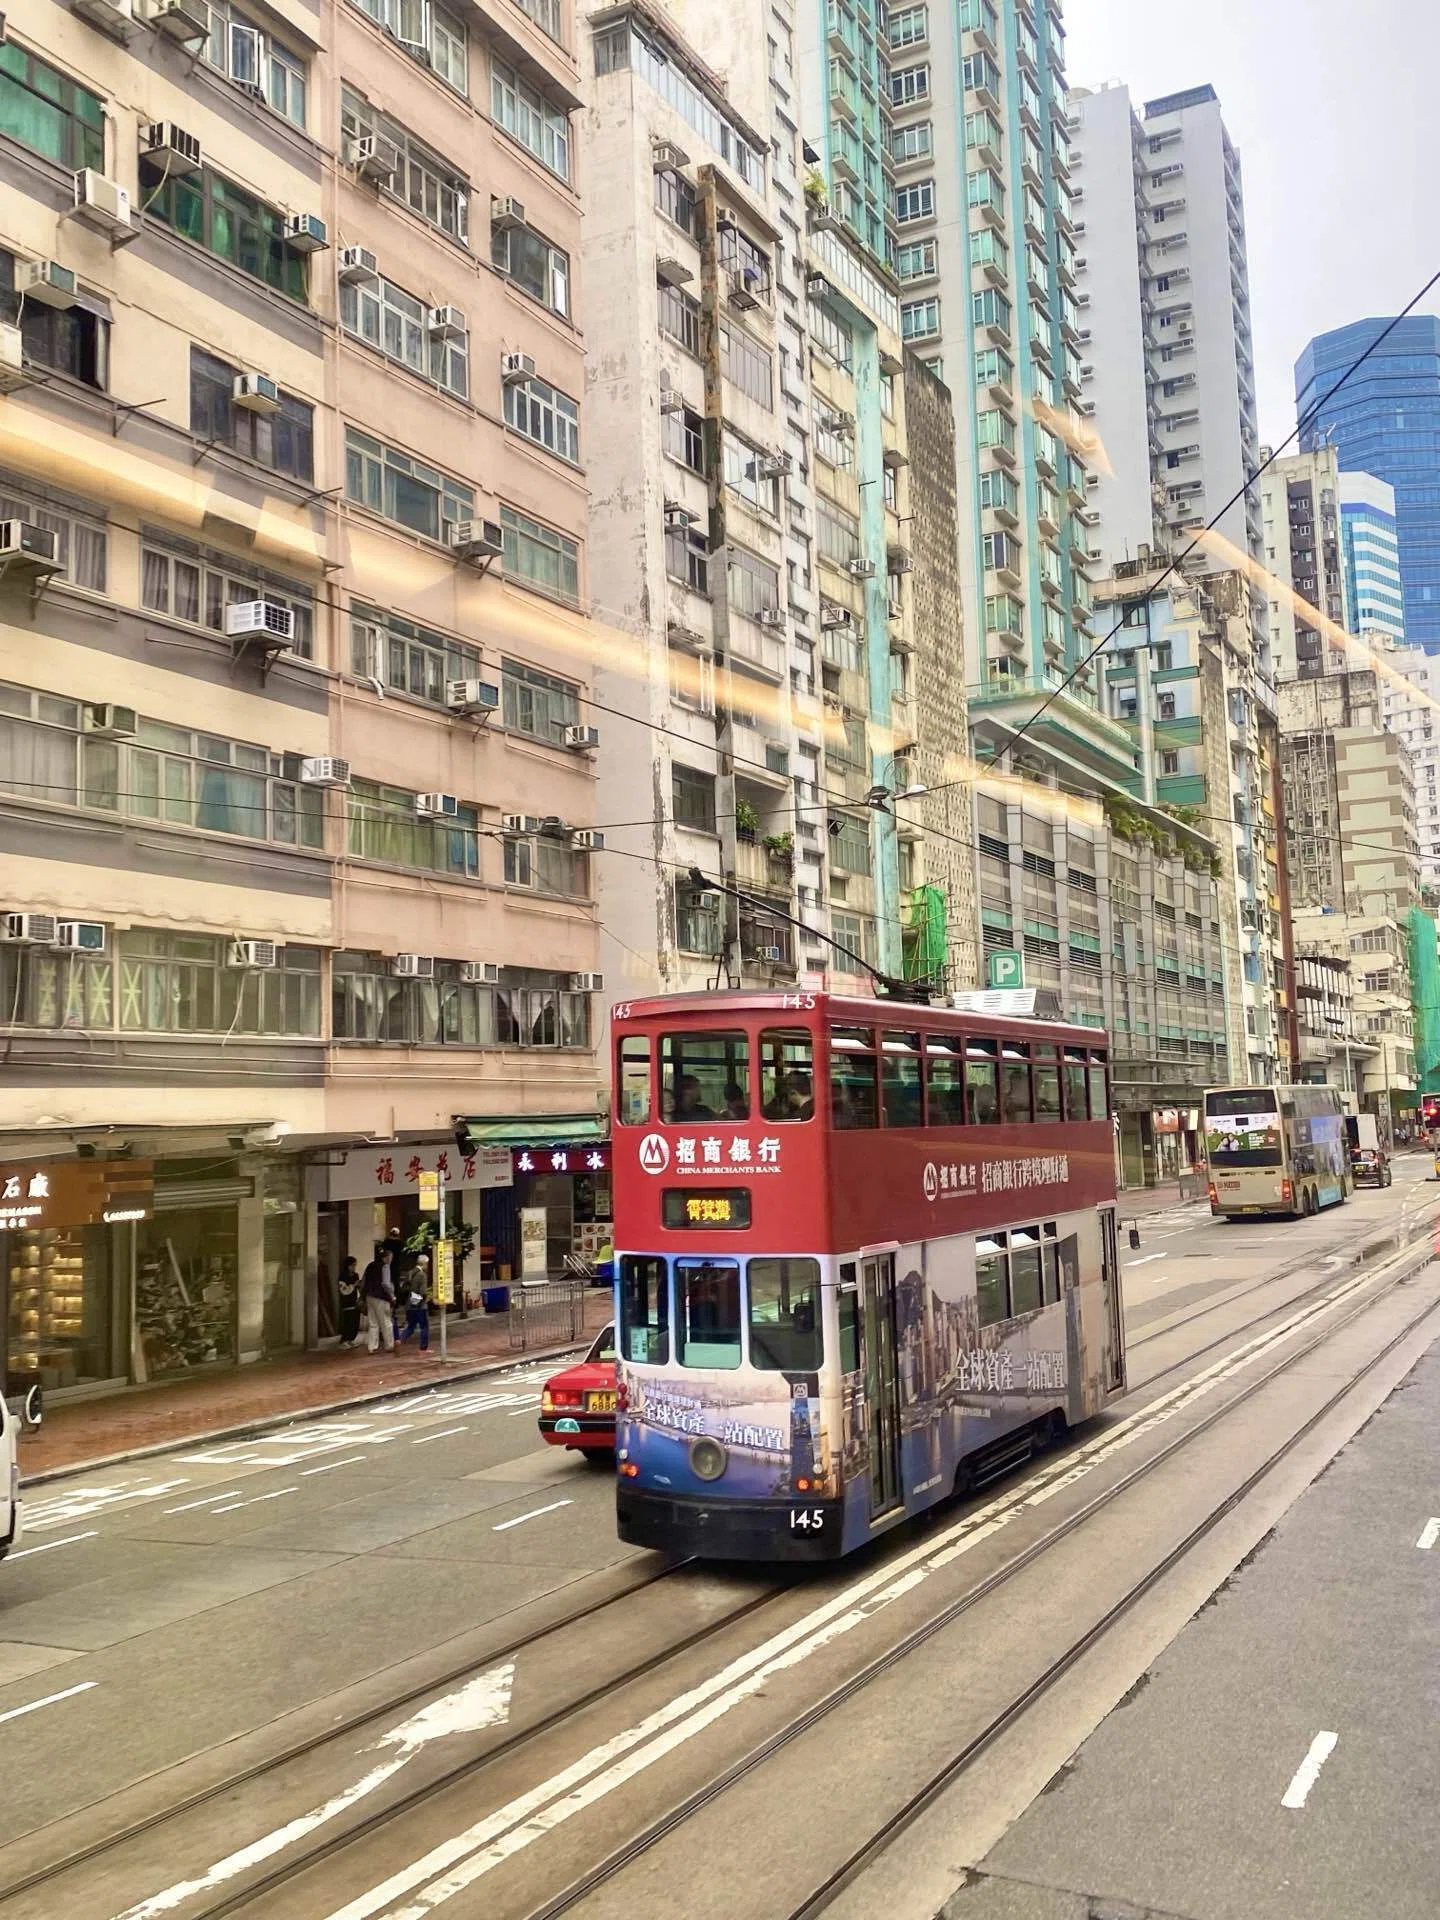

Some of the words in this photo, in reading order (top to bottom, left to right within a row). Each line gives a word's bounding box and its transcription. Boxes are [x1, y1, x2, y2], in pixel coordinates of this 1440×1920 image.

[996, 957, 1016, 984] P
[783, 993, 816, 1010] 145
[612, 1003, 632, 1020] 145
[675, 1135, 781, 1164] 招商銀行
[676, 1167, 701, 1175] CHINA
[702, 1166, 755, 1174] MERCHANTS
[756, 1165, 781, 1173] BANK
[789, 1509, 824, 1529] 145
